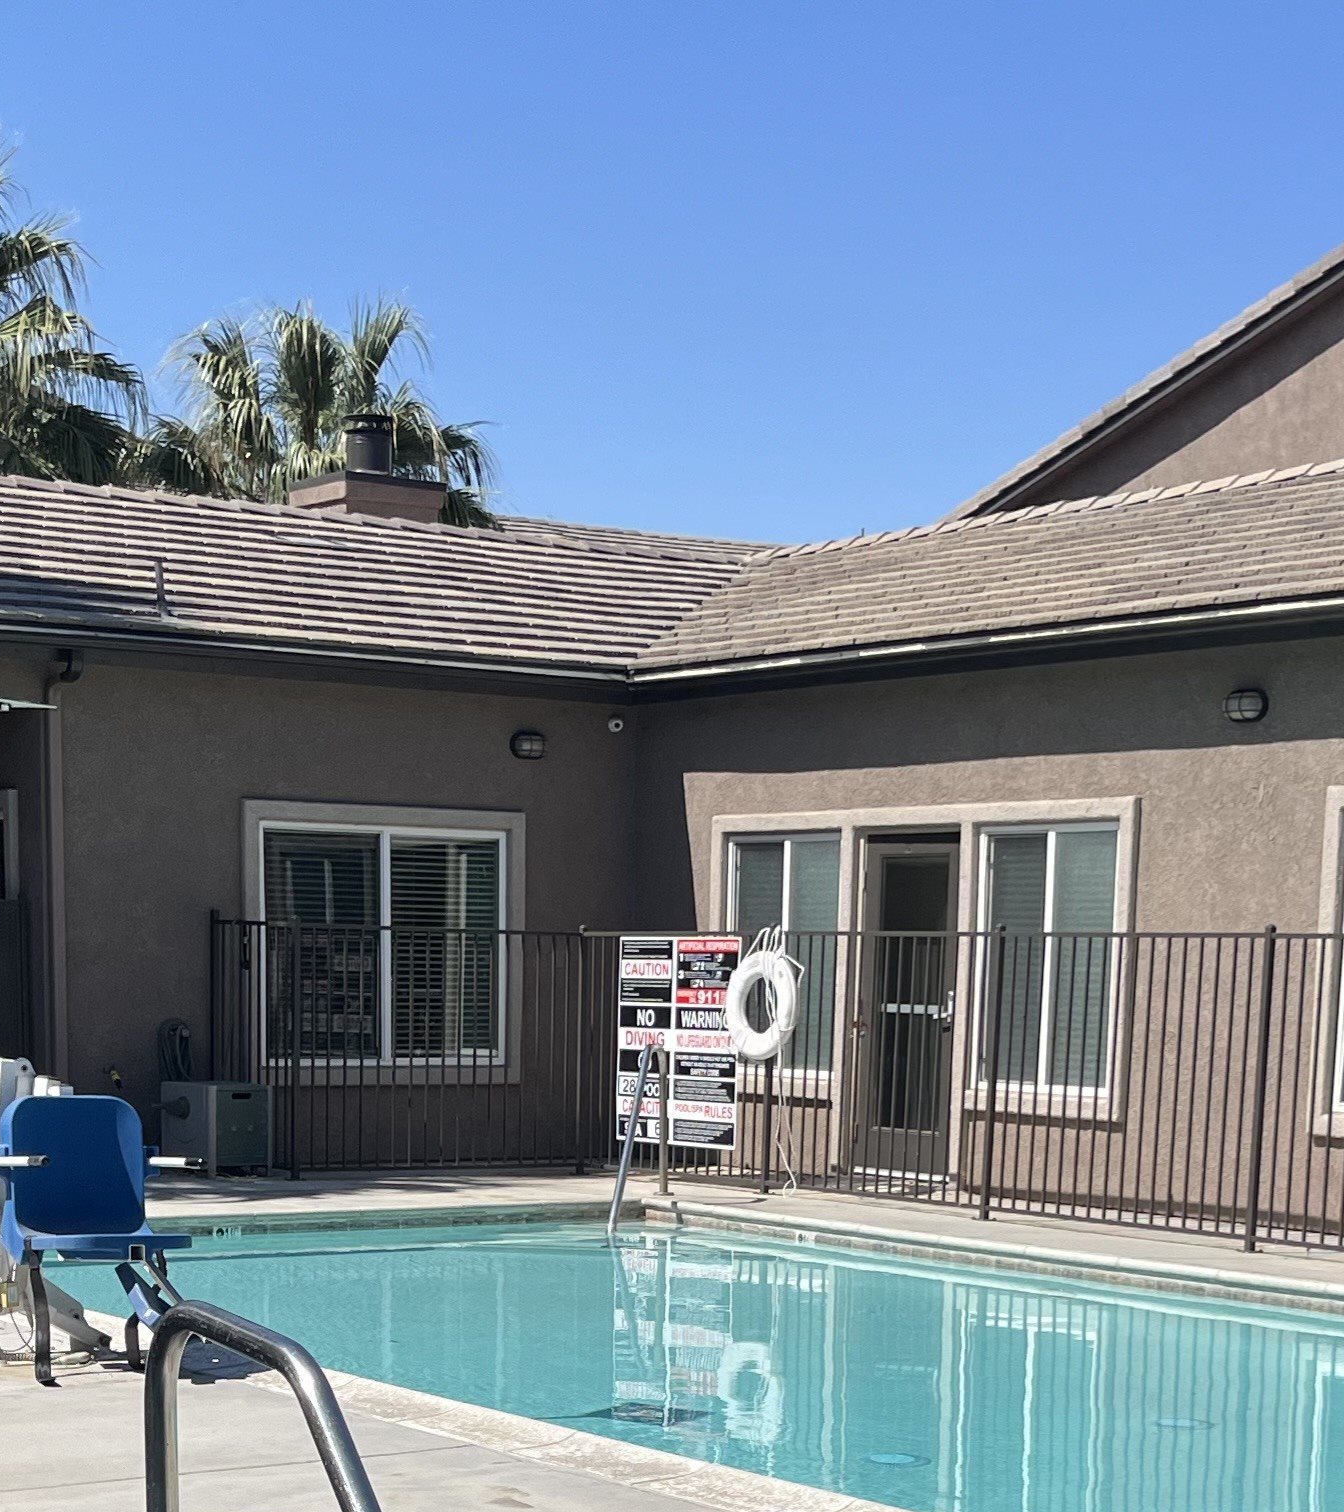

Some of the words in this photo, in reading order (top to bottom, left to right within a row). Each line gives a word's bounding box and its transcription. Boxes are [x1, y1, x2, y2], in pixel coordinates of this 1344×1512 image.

[624, 962, 669, 976] CAUTION
[697, 990, 721, 1004] 911
[636, 1009, 655, 1027] NO
[625, 1030, 665, 1046] DIVING
[704, 1105, 734, 1120] RULES
